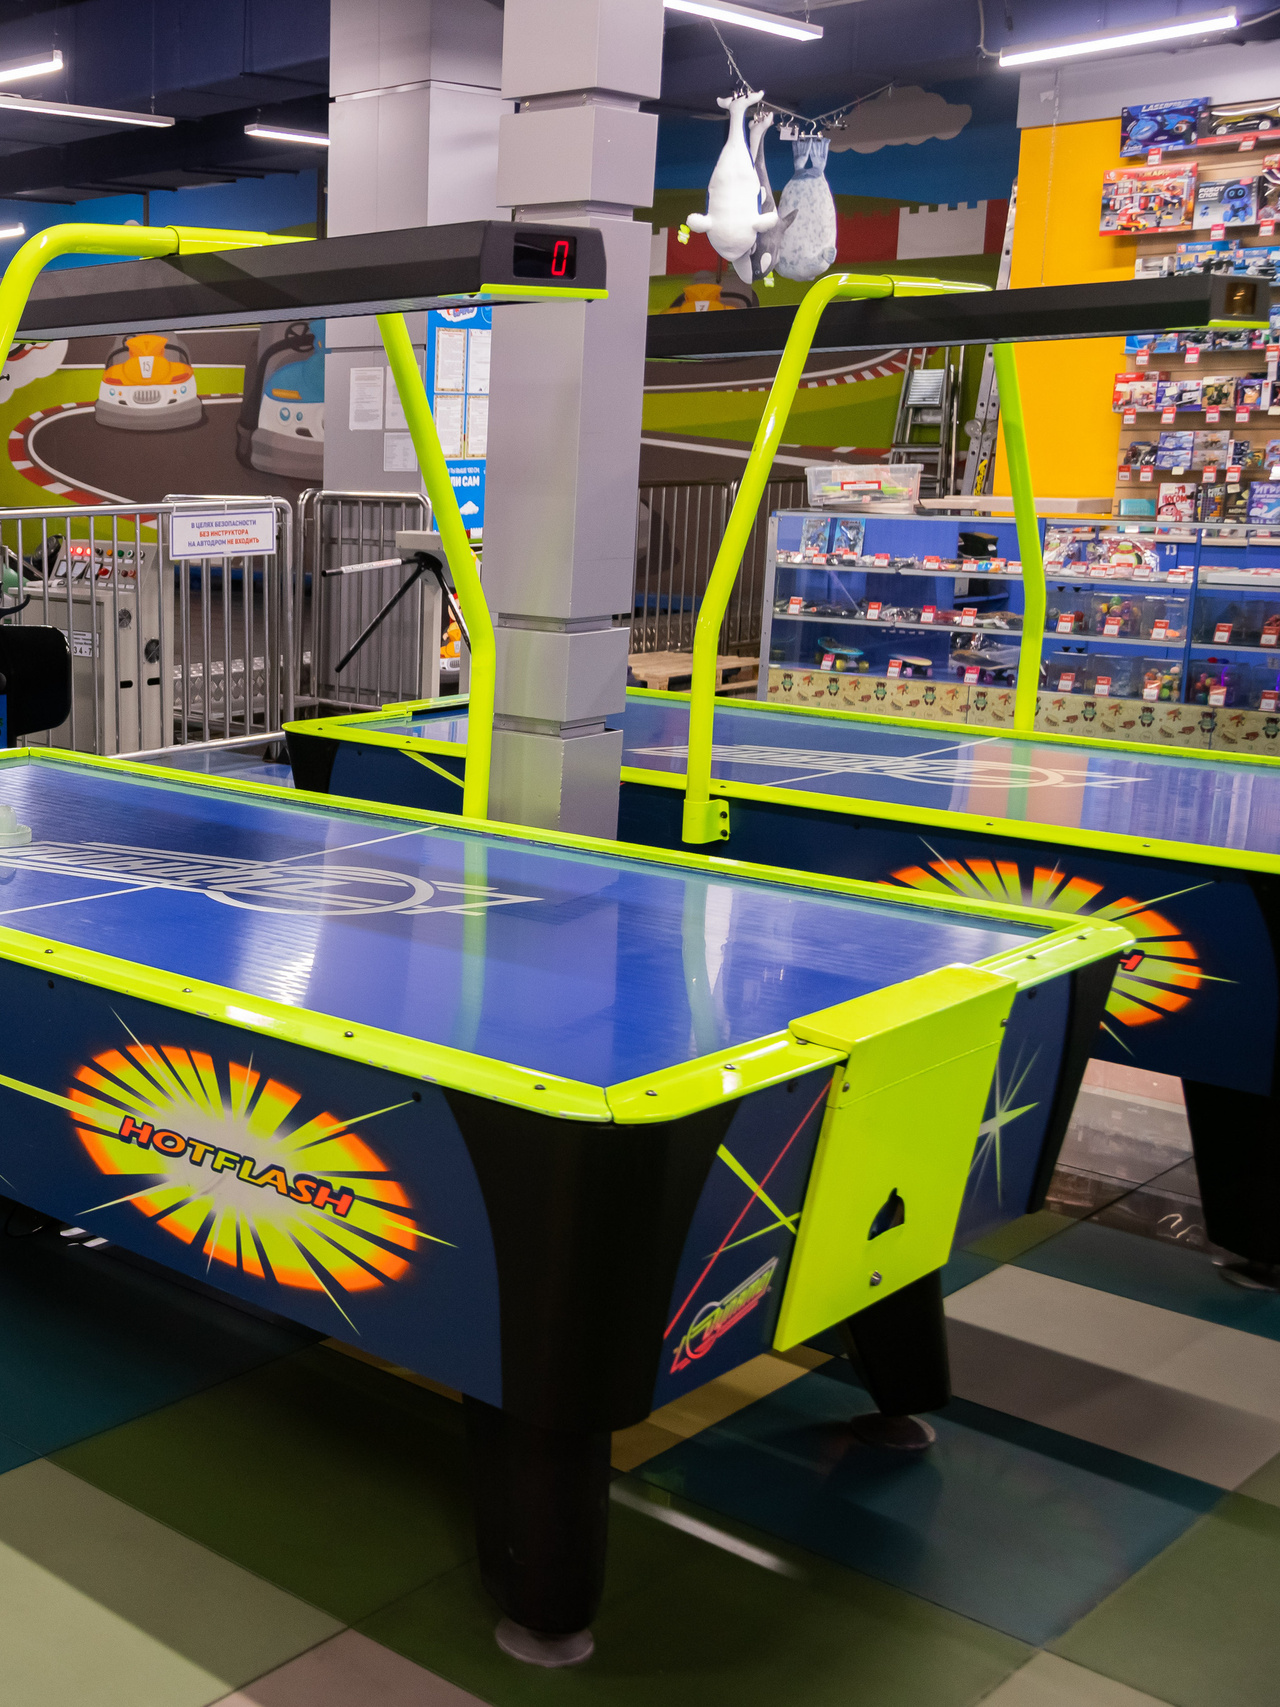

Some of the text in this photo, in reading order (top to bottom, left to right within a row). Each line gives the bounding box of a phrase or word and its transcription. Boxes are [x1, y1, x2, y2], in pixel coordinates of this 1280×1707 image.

[551, 240, 569, 276] 0
[142, 361, 151, 372] 15
[462, 475, 480, 487] САМ
[196, 521, 214, 529] ЦЕЛЯХ
[214, 519, 257, 528] БЕЗОПАСНОСТИ
[210, 529, 249, 537] ИНСТРУКТОРА
[196, 539, 227, 547] АВТОДРОМ
[1165, 544, 1177, 556] 13
[118, 1115, 356, 1218] HOTFLASH
